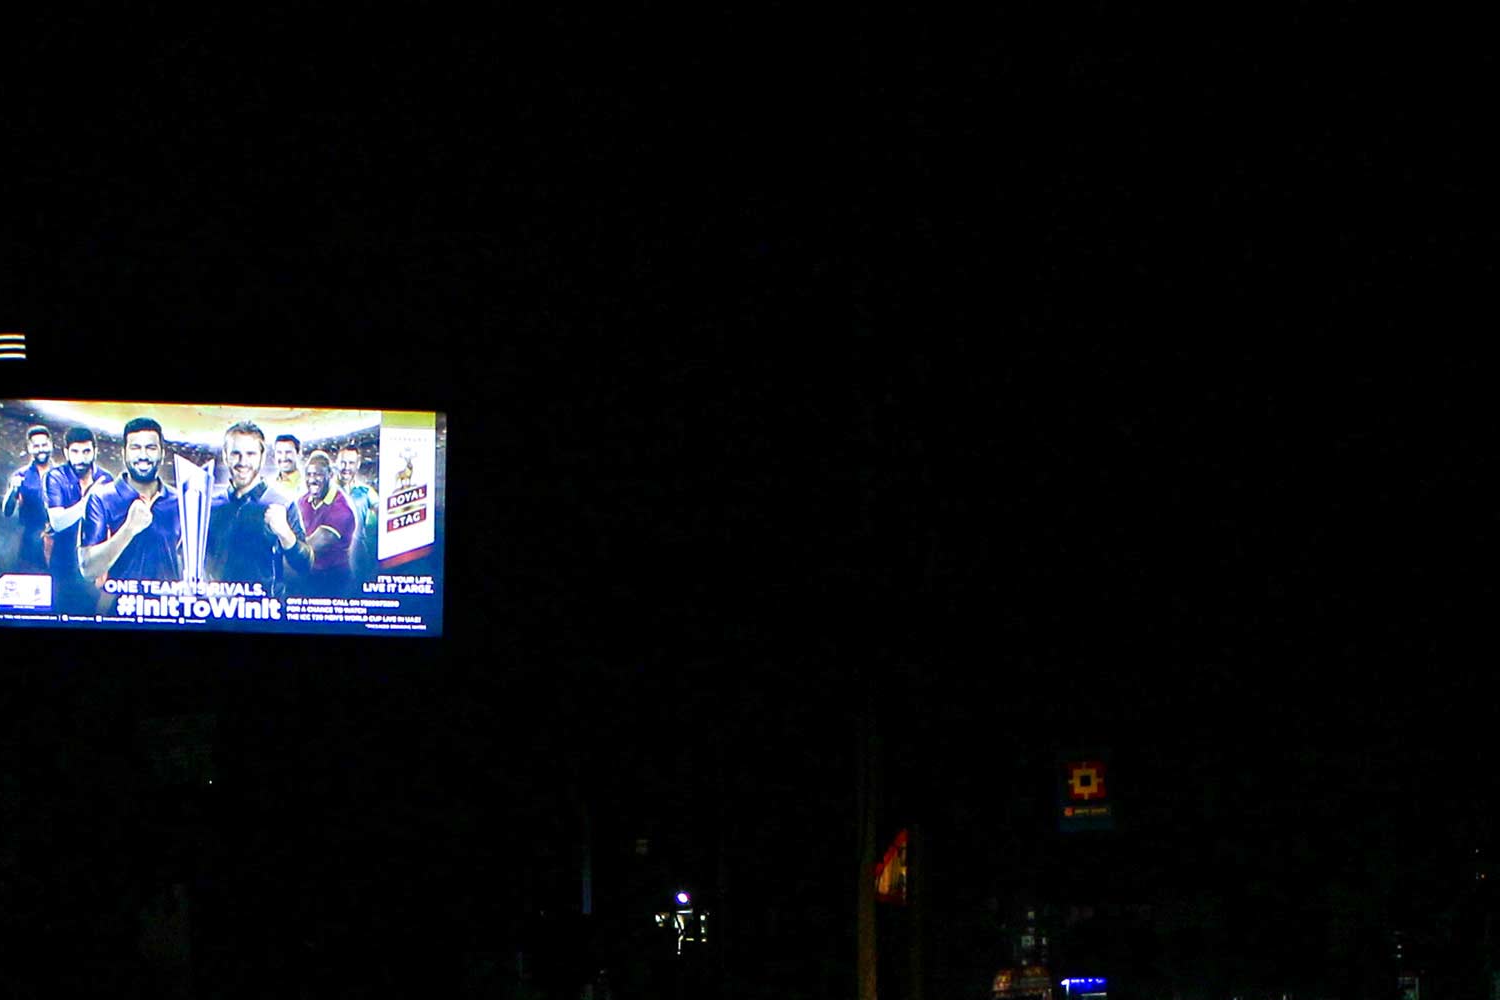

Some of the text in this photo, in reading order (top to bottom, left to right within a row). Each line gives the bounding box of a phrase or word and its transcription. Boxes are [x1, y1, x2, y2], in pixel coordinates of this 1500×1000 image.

[389, 489, 425, 508] ROYAL
[392, 512, 421, 529] STAG
[104, 580, 138, 593] ONE
[393, 575, 415, 584] YOUR
[363, 582, 385, 593] LIVE
[387, 583, 397, 593] IT
[117, 594, 281, 620] #InItToWinIt
